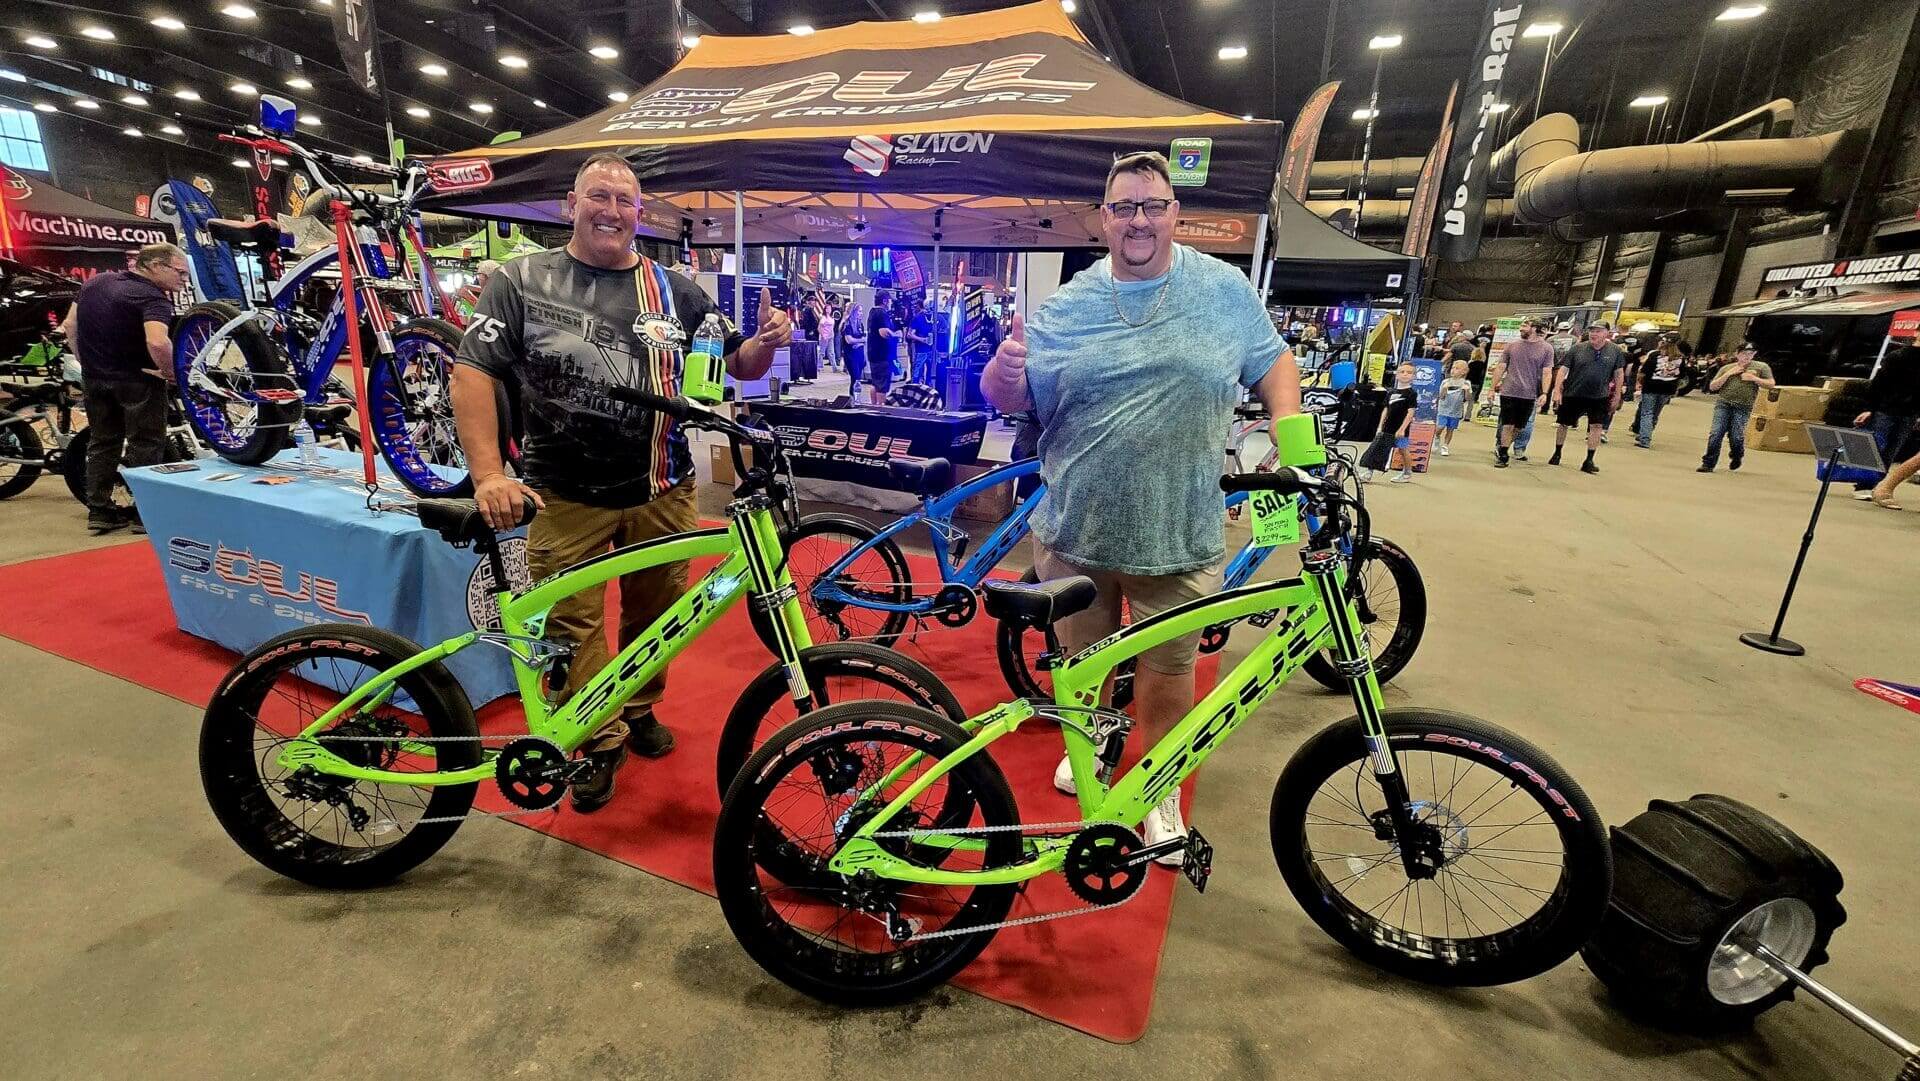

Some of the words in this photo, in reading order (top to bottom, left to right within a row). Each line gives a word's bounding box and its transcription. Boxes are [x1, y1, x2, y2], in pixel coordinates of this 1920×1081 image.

[608, 52, 1097, 123] SOUL
[599, 114, 760, 134] BEACH
[771, 91, 1073, 119] CRUISERS
[894, 132, 996, 155] SLATON
[1175, 140, 1206, 148] ROAD
[894, 155, 948, 167] Racing
[1183, 155, 1194, 168] 2
[7, 211, 167, 245] Machine.com
[1764, 263, 1835, 283] UNLIMITED
[1833, 260, 1849, 278] 4
[1846, 254, 1904, 275] WHEEL
[464, 313, 506, 343] 75
[526, 304, 583, 328] FINISH
[774, 425, 928, 464] SOUL
[168, 537, 373, 626] SOUL
[179, 574, 239, 600] FAST
[1142, 621, 1333, 805] SOUL
[784, 721, 862, 757] SOUL
[862, 720, 942, 744] FAST
[1423, 732, 1510, 764] SOUL
[1509, 760, 1582, 822] FAST
